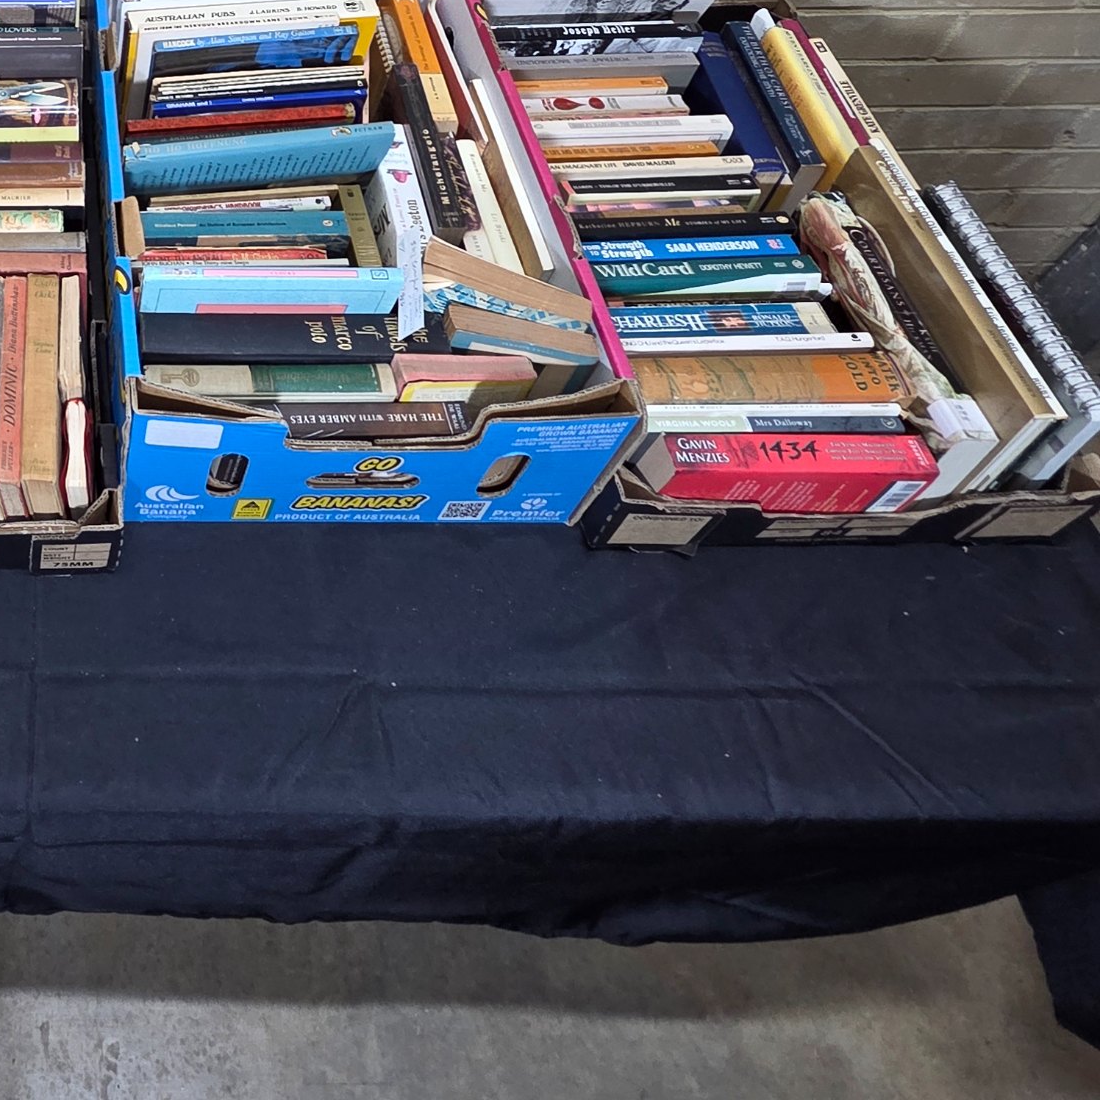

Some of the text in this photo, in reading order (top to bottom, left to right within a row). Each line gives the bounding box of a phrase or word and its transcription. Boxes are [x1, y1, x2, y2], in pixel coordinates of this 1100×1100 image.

[144, 13, 205, 23] AUSTRALIAN
[211, 10, 236, 18] PUBS
[562, 25, 636, 37] Joseph Heller
[163, 38, 195, 48] HANCOCK
[228, 34, 256, 45] Simpson
[258, 32, 272, 40] and
[274, 31, 289, 40] Ray
[750, 42, 769, 67] BIRTH
[771, 82, 793, 111] CHRIST
[839, 81, 880, 134] KATE GRENVILLE
[421, 128, 450, 206] Michelangelo
[878, 149, 915, 197] MELBOURNE
[915, 205, 943, 239] COLOUR
[664, 218, 680, 227] Me
[601, 240, 645, 250] Strength
[665, 240, 759, 253] SARA HENDERSON
[601, 250, 653, 259] Strength
[642, 262, 695, 276] Card
[733, 262, 763, 270] HEWETT
[611, 315, 687, 331] CHARLES
[305, 320, 328, 344] polo
[331, 316, 352, 351] marco
[355, 324, 384, 340] of
[7, 332, 17, 354] Diana
[838, 354, 868, 392] GOLD
[859, 356, 881, 386] INTO
[871, 352, 900, 394] WATER
[4, 363, 19, 428] DOMINIC
[290, 412, 445, 424] THE HARE WITH AMBER EYES
[655, 418, 813, 430] VIRGINIA WOOLF Mrs Dalloway
[517, 422, 628, 433] PREMIUM AUSTRALIAN
[676, 437, 717, 450] GAVIN
[676, 450, 730, 464] MENZIES
[760, 441, 820, 463] 1434
[358, 457, 399, 472] GO
[135, 502, 204, 510] Australian
[295, 495, 425, 510] BANANAS!
[353, 513, 420, 521] AUSTRALIA
[492, 509, 565, 519] Premier
